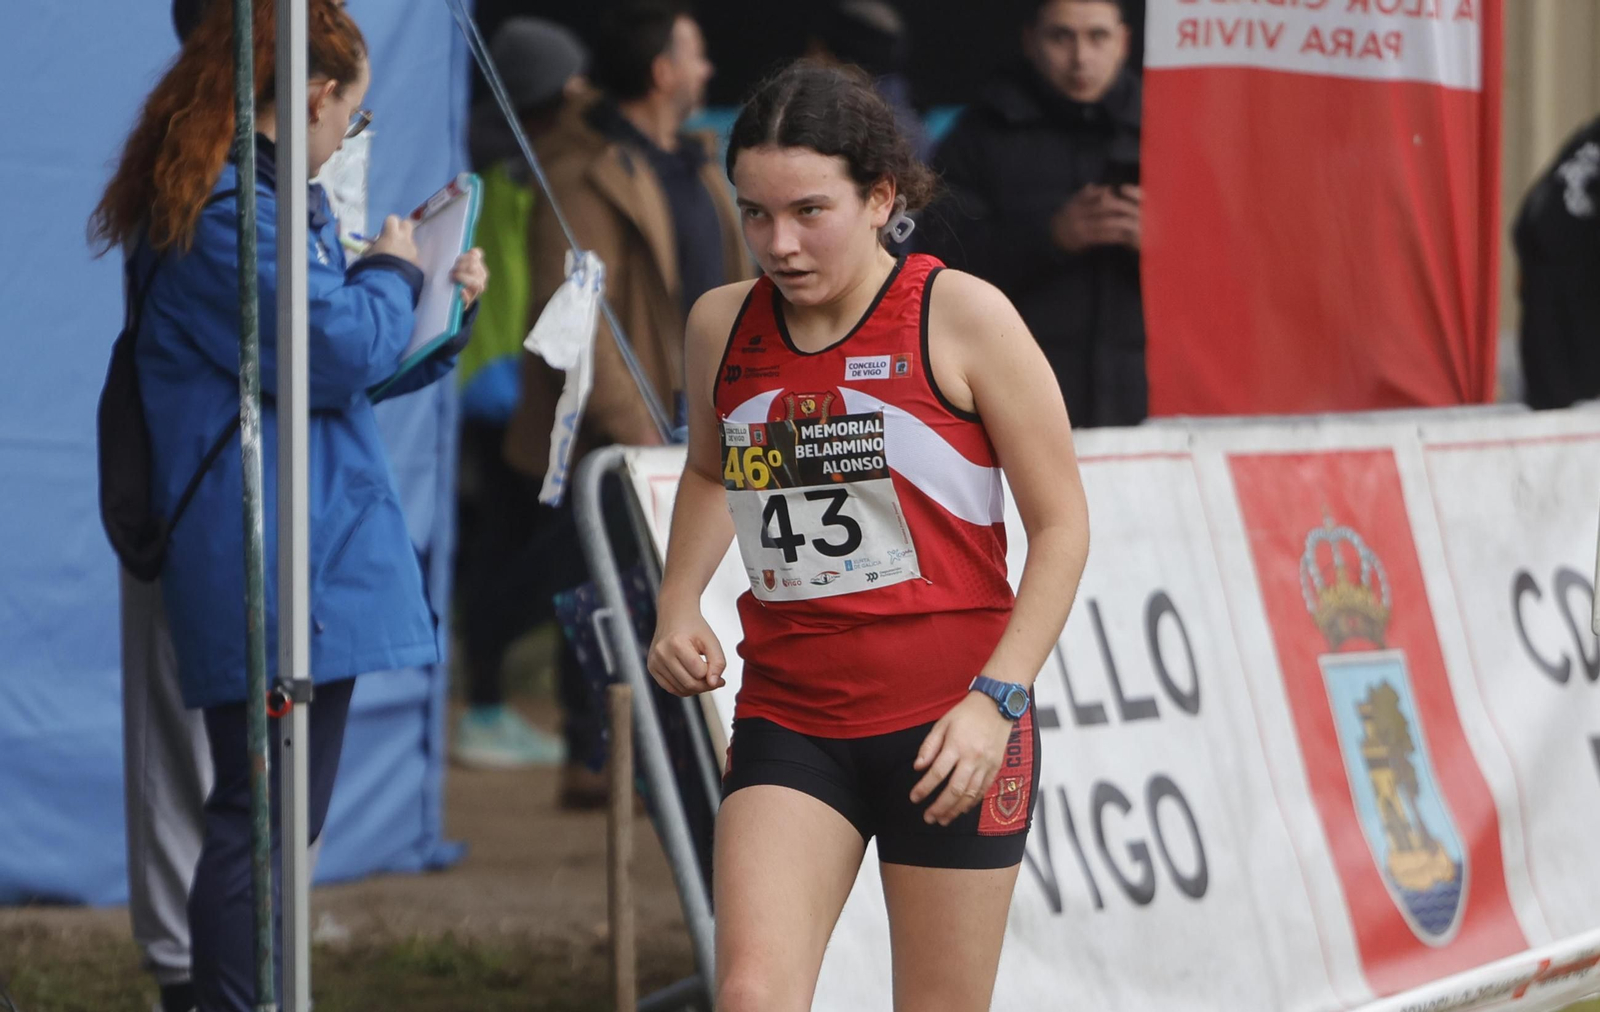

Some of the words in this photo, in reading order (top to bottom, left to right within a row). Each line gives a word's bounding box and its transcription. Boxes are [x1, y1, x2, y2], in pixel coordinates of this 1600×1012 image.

[848, 361, 887, 370] CONCELLO
[801, 419, 884, 440] MEMORIAL
[795, 437, 884, 459] BELARMINO
[822, 456, 884, 475] ALONSO
[760, 488, 863, 564] 43
[1024, 773, 1209, 916] VIGO
